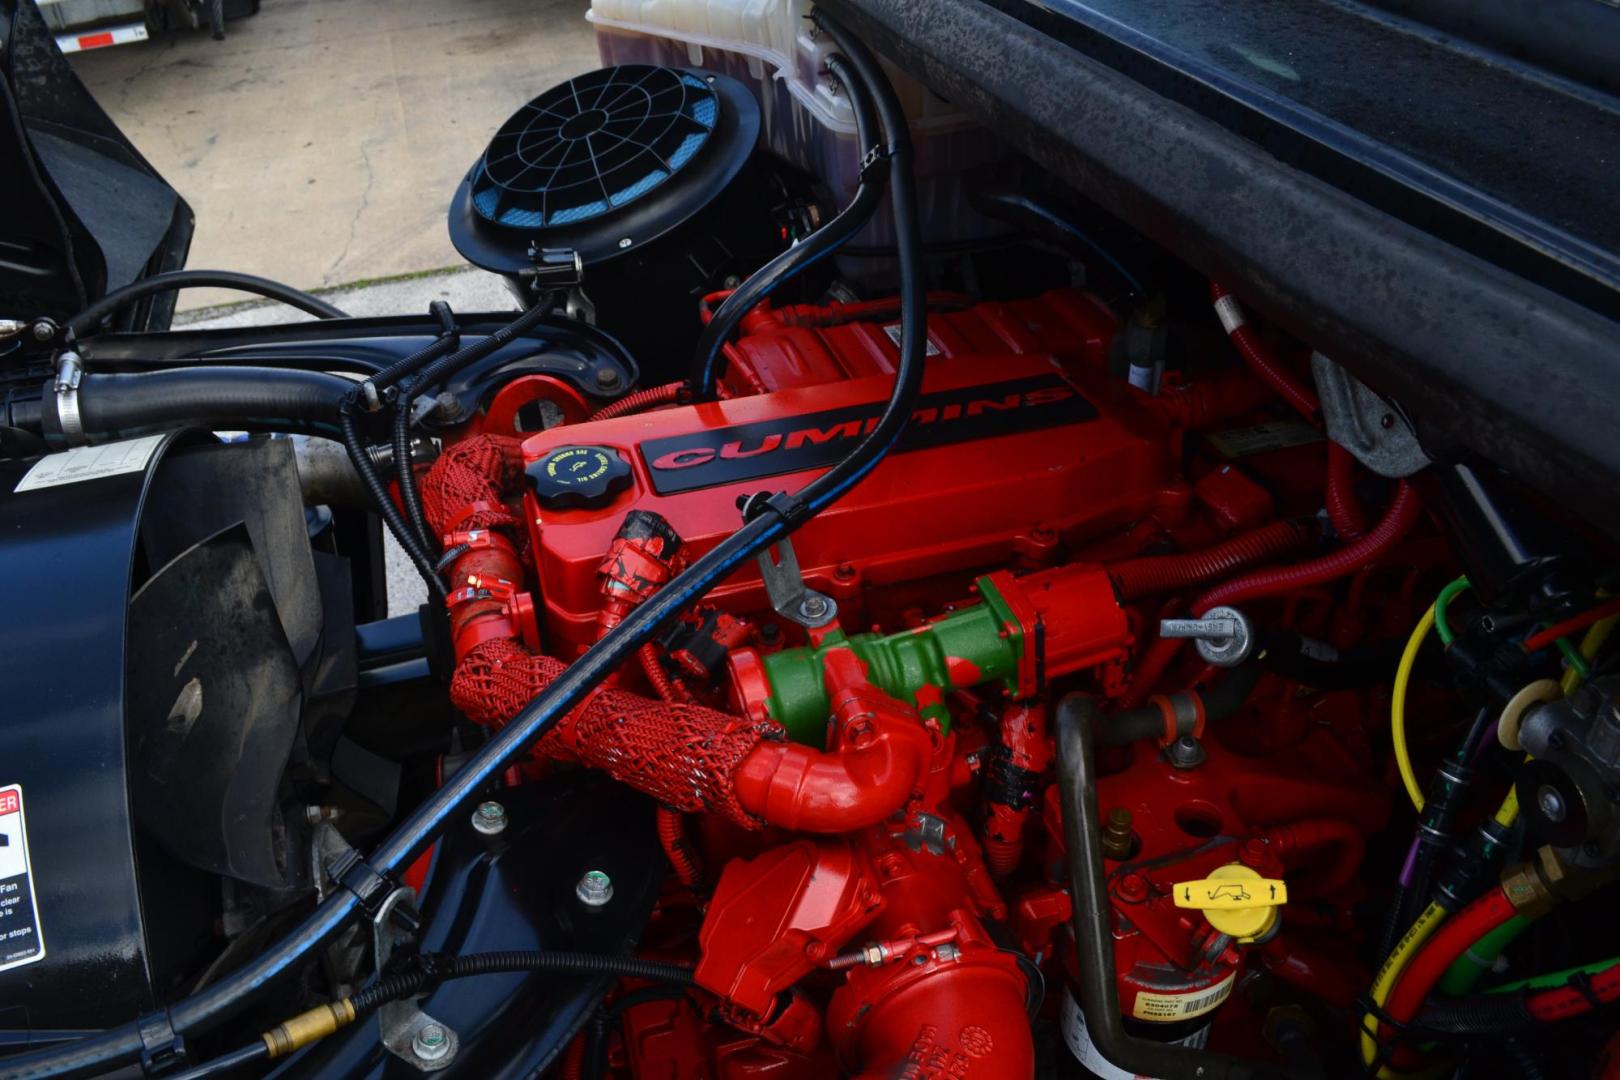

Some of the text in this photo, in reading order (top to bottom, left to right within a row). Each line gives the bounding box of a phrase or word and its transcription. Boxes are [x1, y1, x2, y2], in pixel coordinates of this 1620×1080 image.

[0, 883, 18, 894] Fan
[0, 896, 21, 907] clear
[5, 908, 13, 916] is
[8, 926, 32, 938] stops
